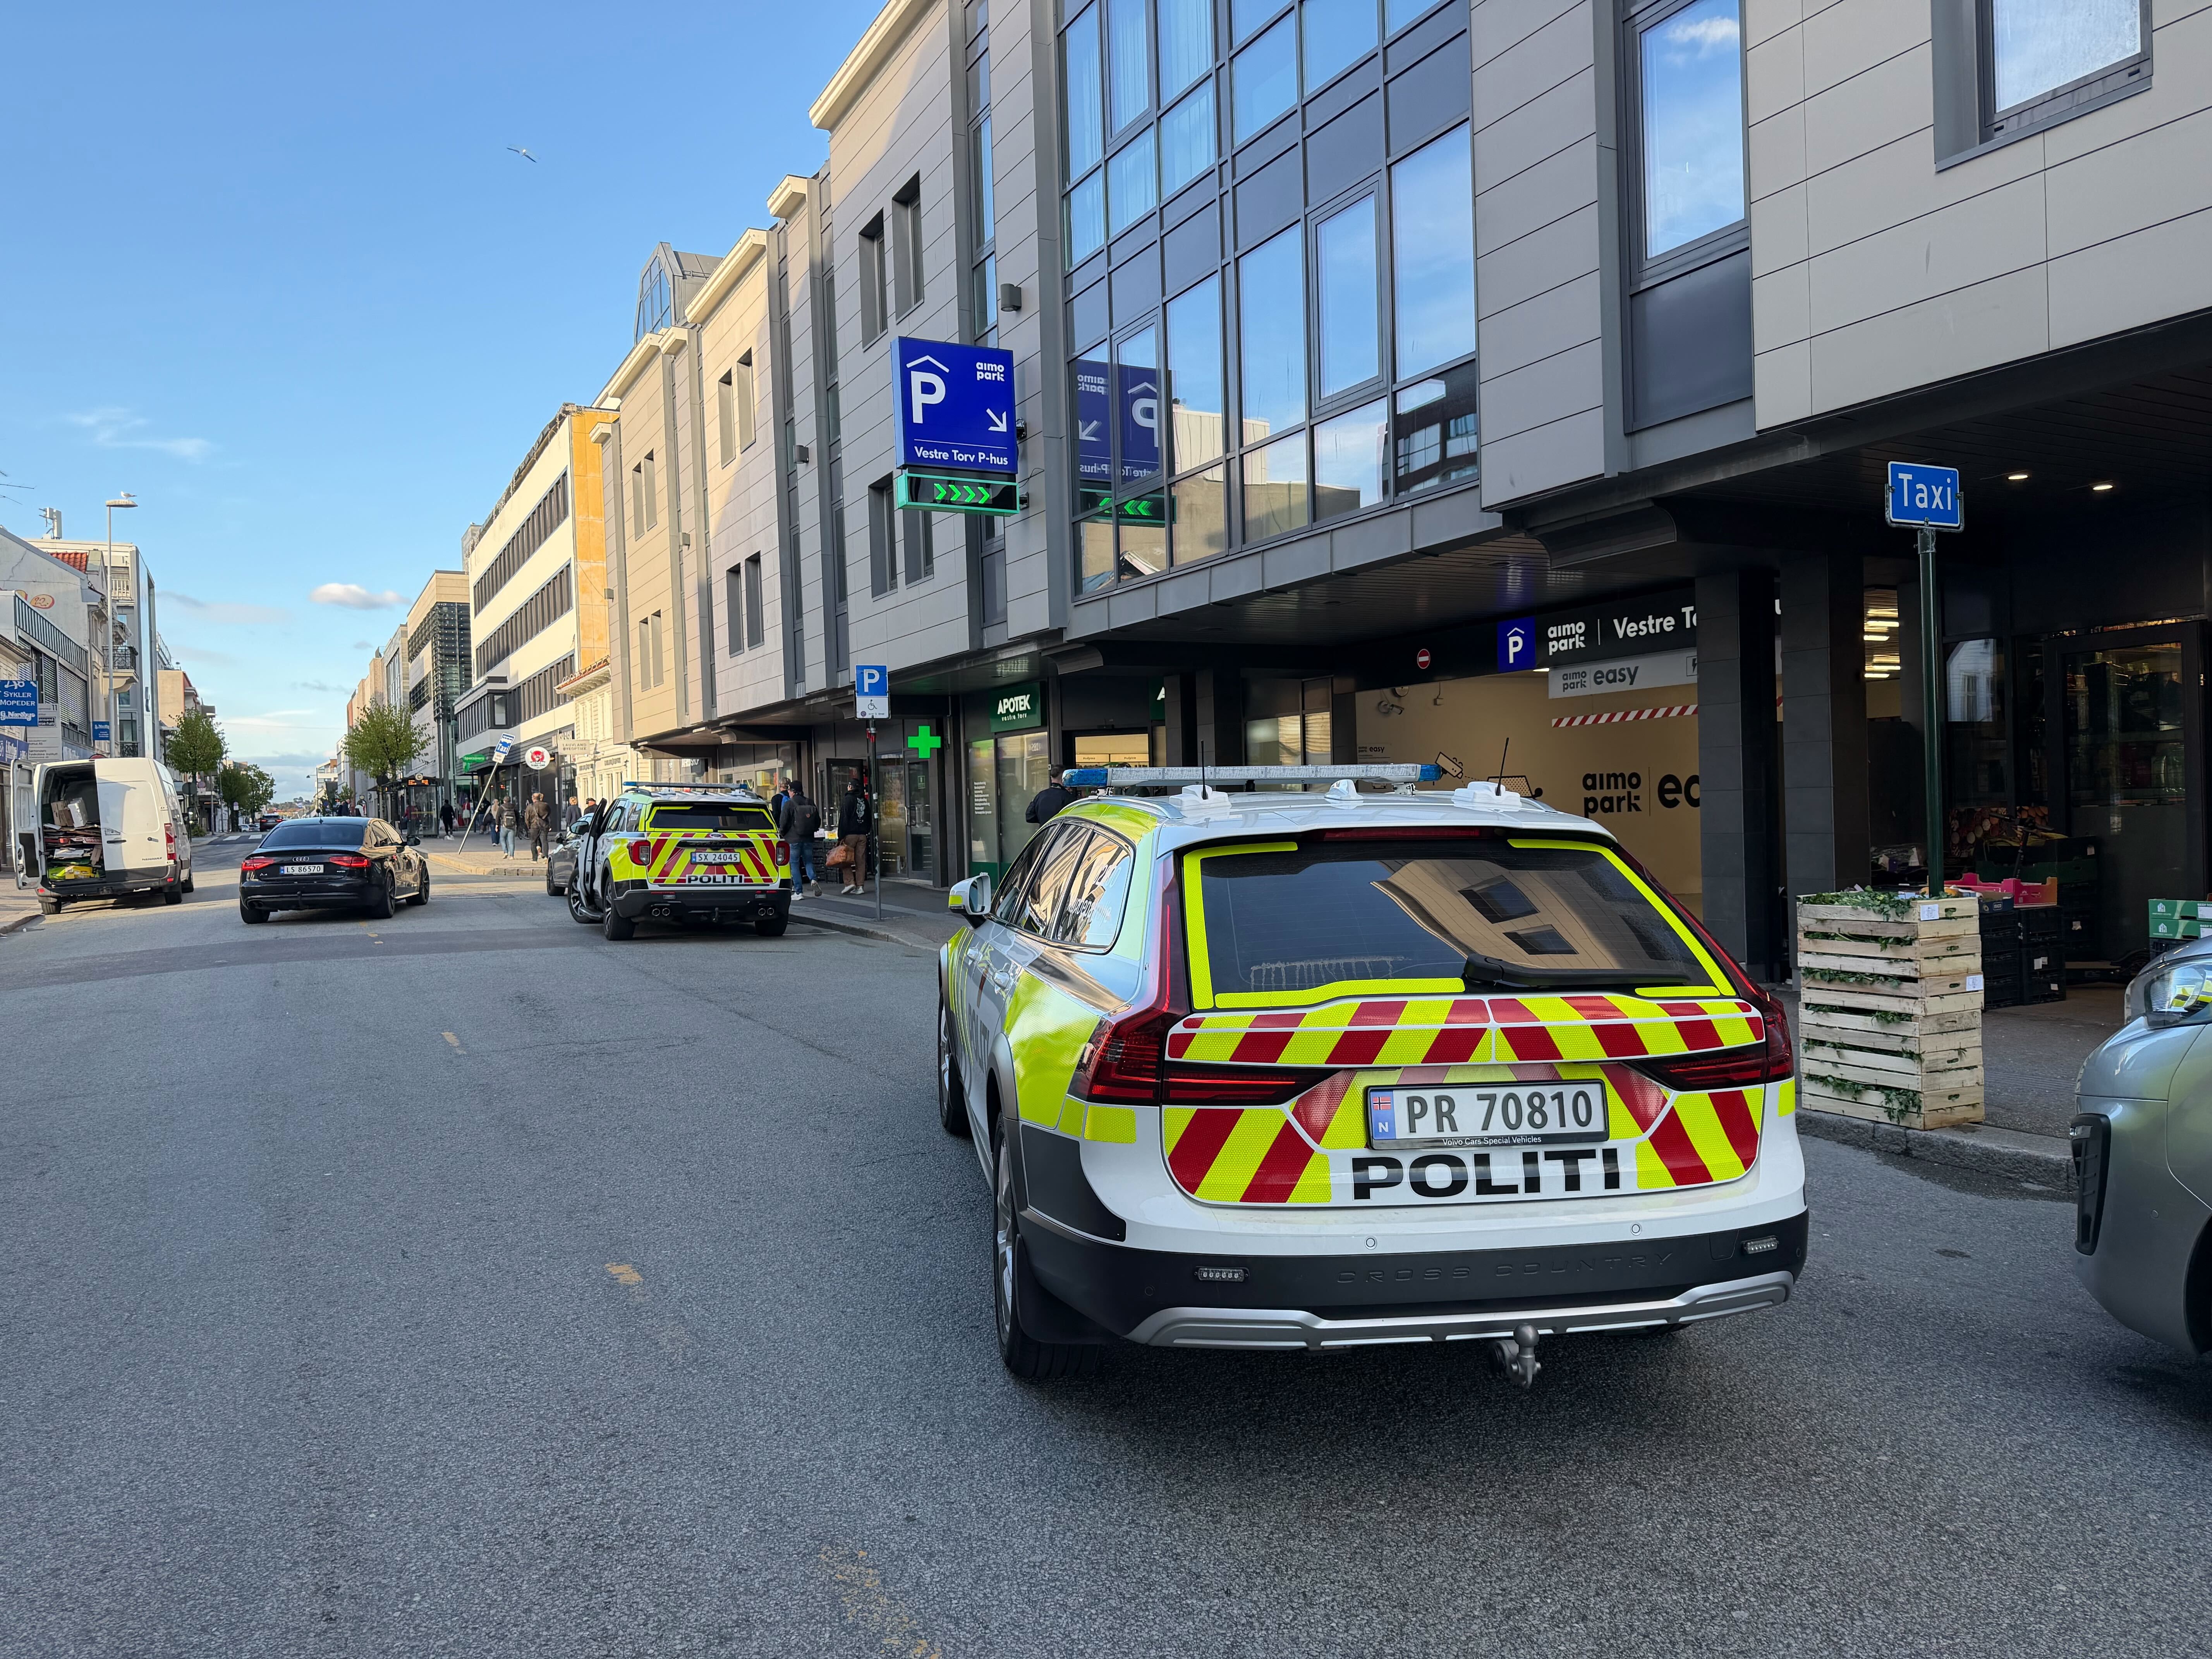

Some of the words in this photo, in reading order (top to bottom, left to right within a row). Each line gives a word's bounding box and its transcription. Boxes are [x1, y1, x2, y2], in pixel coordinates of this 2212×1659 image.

[976, 362, 1005, 373] aimo
[977, 371, 1005, 381] park
[911, 371, 946, 424] P
[914, 446, 949, 460] Vestre
[951, 449, 975, 462] Torv
[978, 452, 1008, 465] P-hus
[1898, 473, 1952, 510] Taxi
[1548, 621, 1586, 638] aimo
[1613, 615, 1675, 639] Vestre
[1509, 636, 1523, 663] P
[1549, 634, 1586, 656] park
[864, 669, 880, 692] P
[1562, 671, 1587, 681] aimo
[1593, 665, 1639, 685] easy
[1563, 680, 1587, 692] park
[997, 694, 1031, 714] APOTEK
[497, 743, 510, 753] Taxi
[1582, 772, 1642, 791] aimo
[1584, 791, 1642, 819] park
[687, 875, 743, 883] POLITI
[1406, 1094, 1458, 1133] PR
[1477, 1090, 1592, 1131] 70810
[1378, 1121, 1389, 1133] N
[1443, 1138, 1463, 1146] Volvo
[1484, 1137, 1511, 1146] Special
[1512, 1135, 1542, 1144] Vehicles
[1352, 1147, 1620, 1200] POLITI
[1337, 1266, 1471, 1283] CROSS
[1496, 1252, 1673, 1277] COUNTRY
